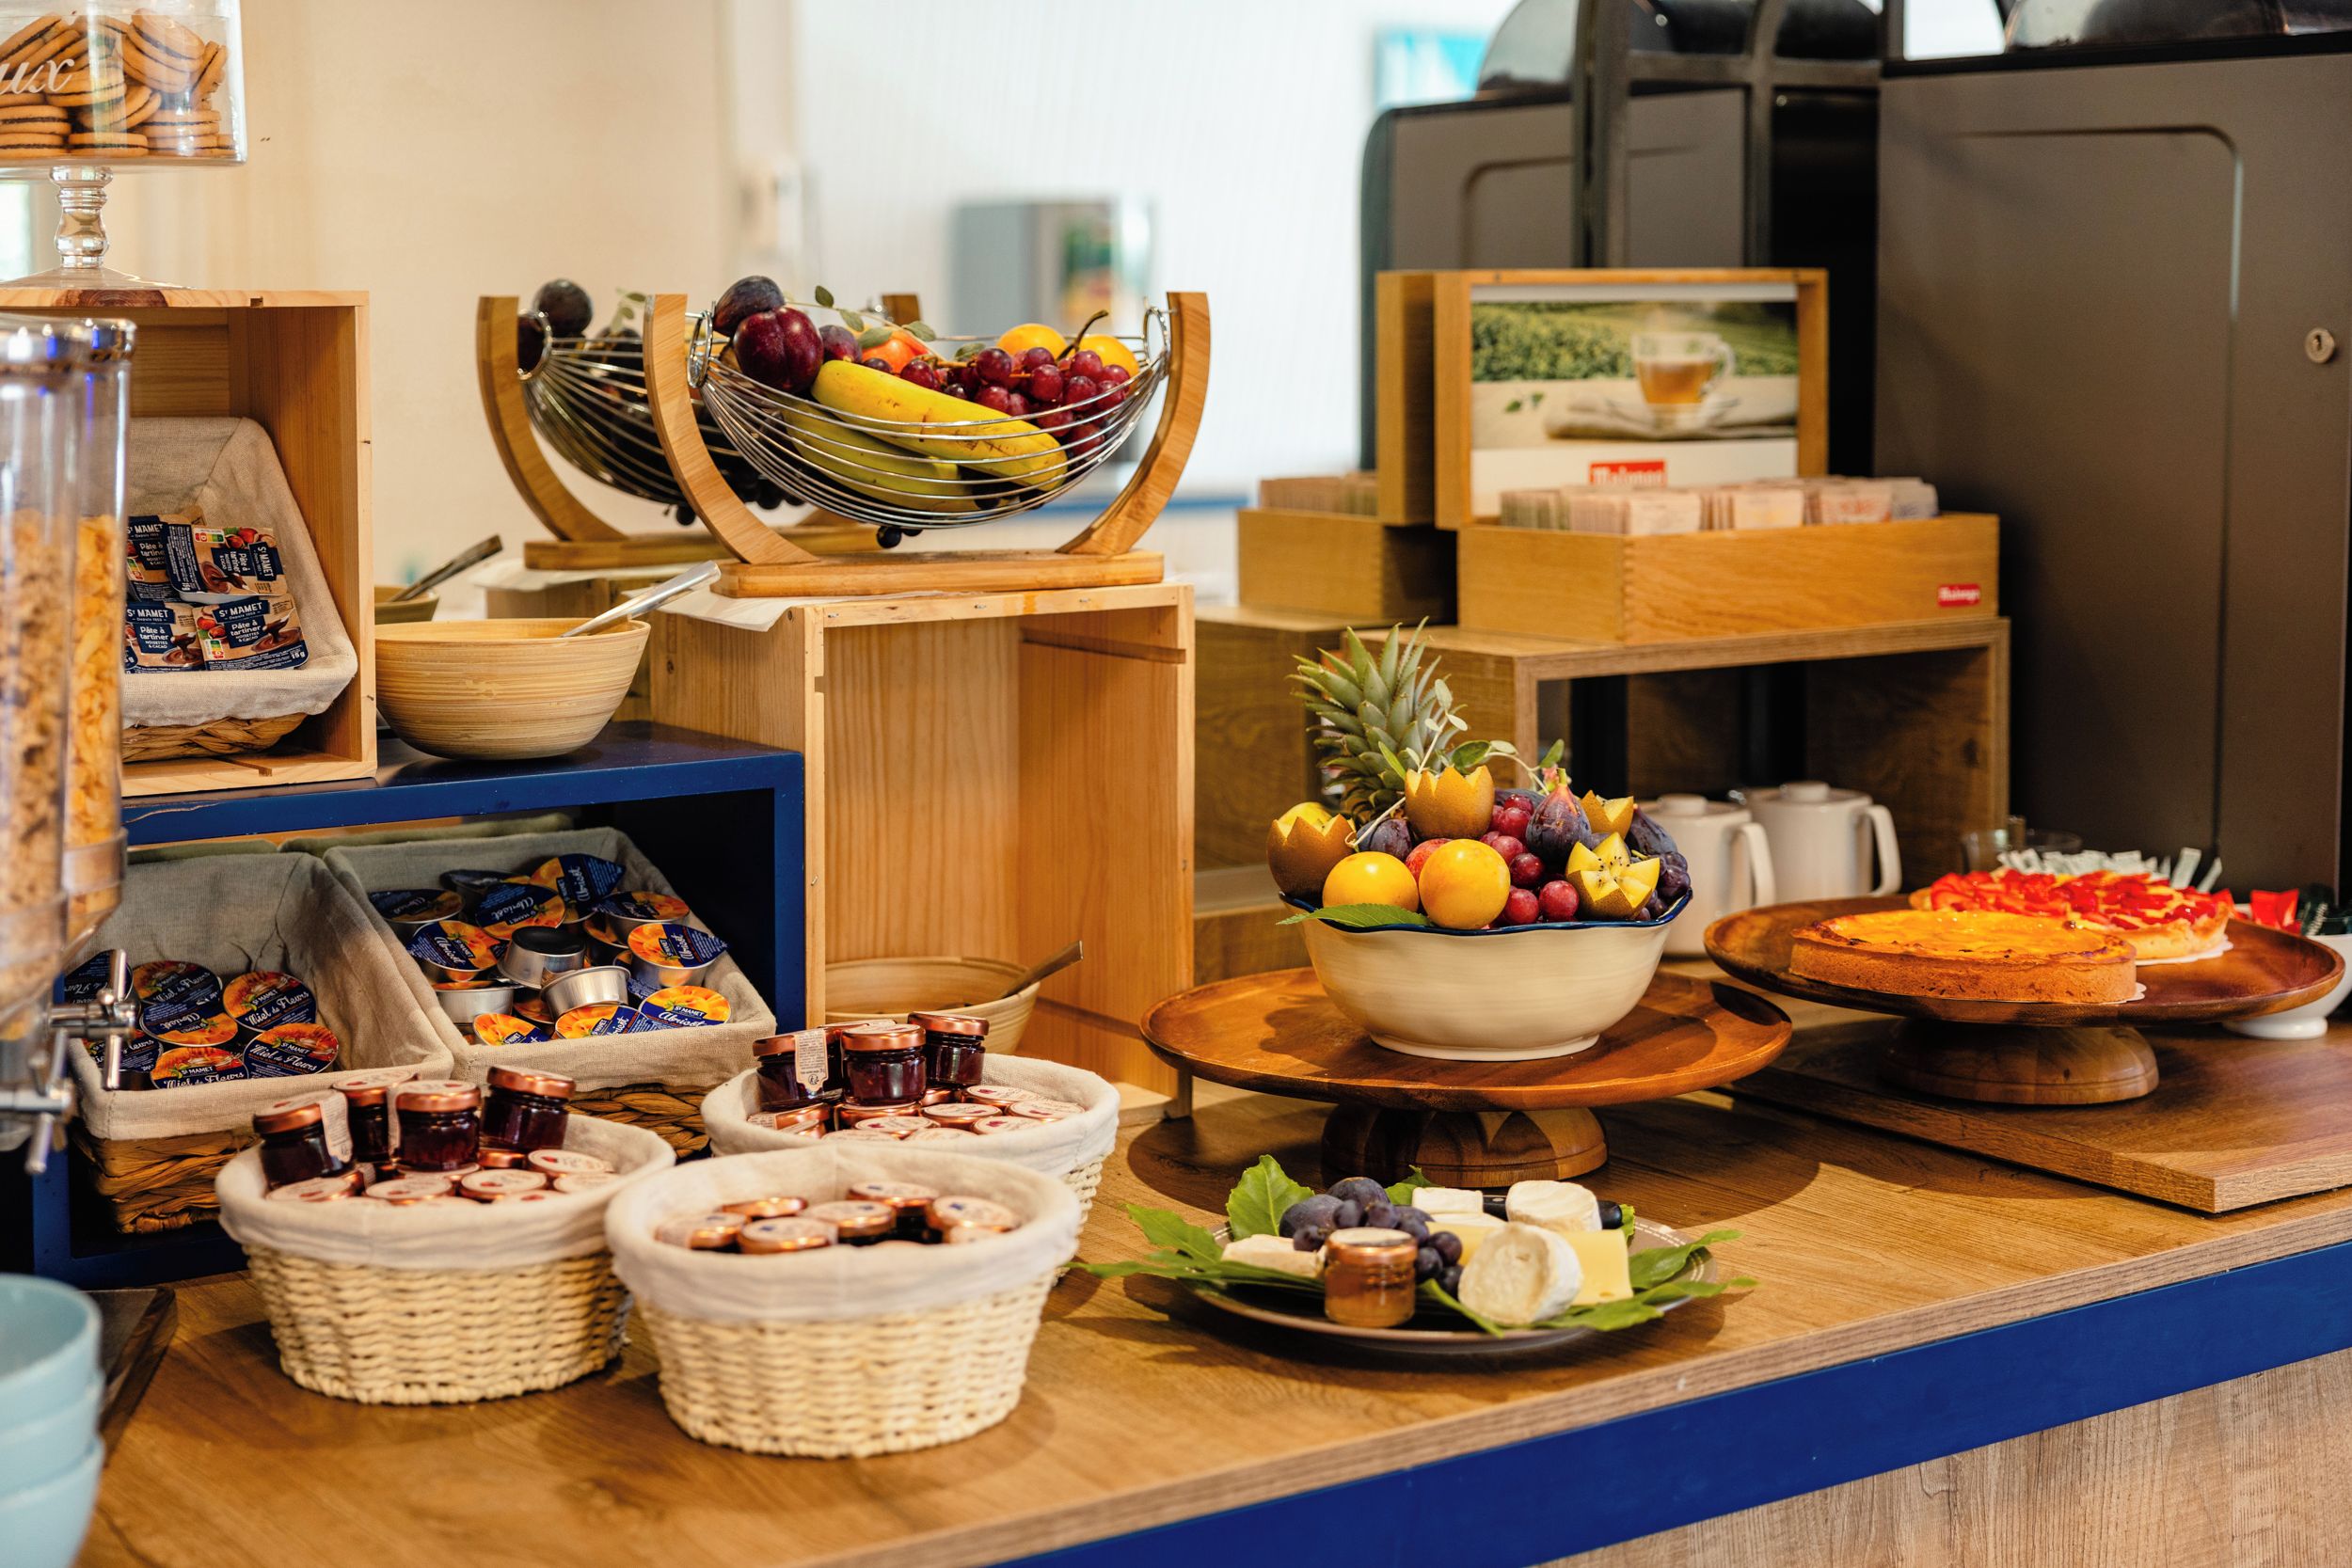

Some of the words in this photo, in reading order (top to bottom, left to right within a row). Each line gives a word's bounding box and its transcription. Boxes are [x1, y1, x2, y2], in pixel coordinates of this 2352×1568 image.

[135, 524, 163, 534] MAMET
[230, 551, 241, 573] tartiner
[259, 553, 274, 577] MAMET
[136, 609, 168, 618] MAMET
[230, 602, 262, 616] MAMET
[140, 626, 158, 634] Pâte
[230, 626, 261, 636] tartiner
[231, 622, 250, 630] Pâte
[568, 865, 591, 901] Abricot
[491, 896, 534, 920] Abricot
[434, 936, 467, 965] Abricot
[670, 933, 694, 959] Abricot
[180, 972, 211, 989] Fleurs
[259, 990, 278, 1002] MAMET
[245, 1007, 272, 1025] Miel
[272, 1006, 280, 1014] de
[276, 991, 310, 1009] Fleurs
[682, 1007, 705, 1017] MAMET
[159, 1012, 200, 1030] Abricot
[658, 1011, 707, 1027] Abricot
[129, 1039, 154, 1051] leurs
[288, 1044, 310, 1054] MAMET
[249, 1044, 279, 1058] Miel
[283, 1054, 317, 1071] Fleurs
[188, 1066, 214, 1074] MAMET
[163, 1078, 192, 1089] Miel
[204, 1071, 245, 1084] Fleurs
